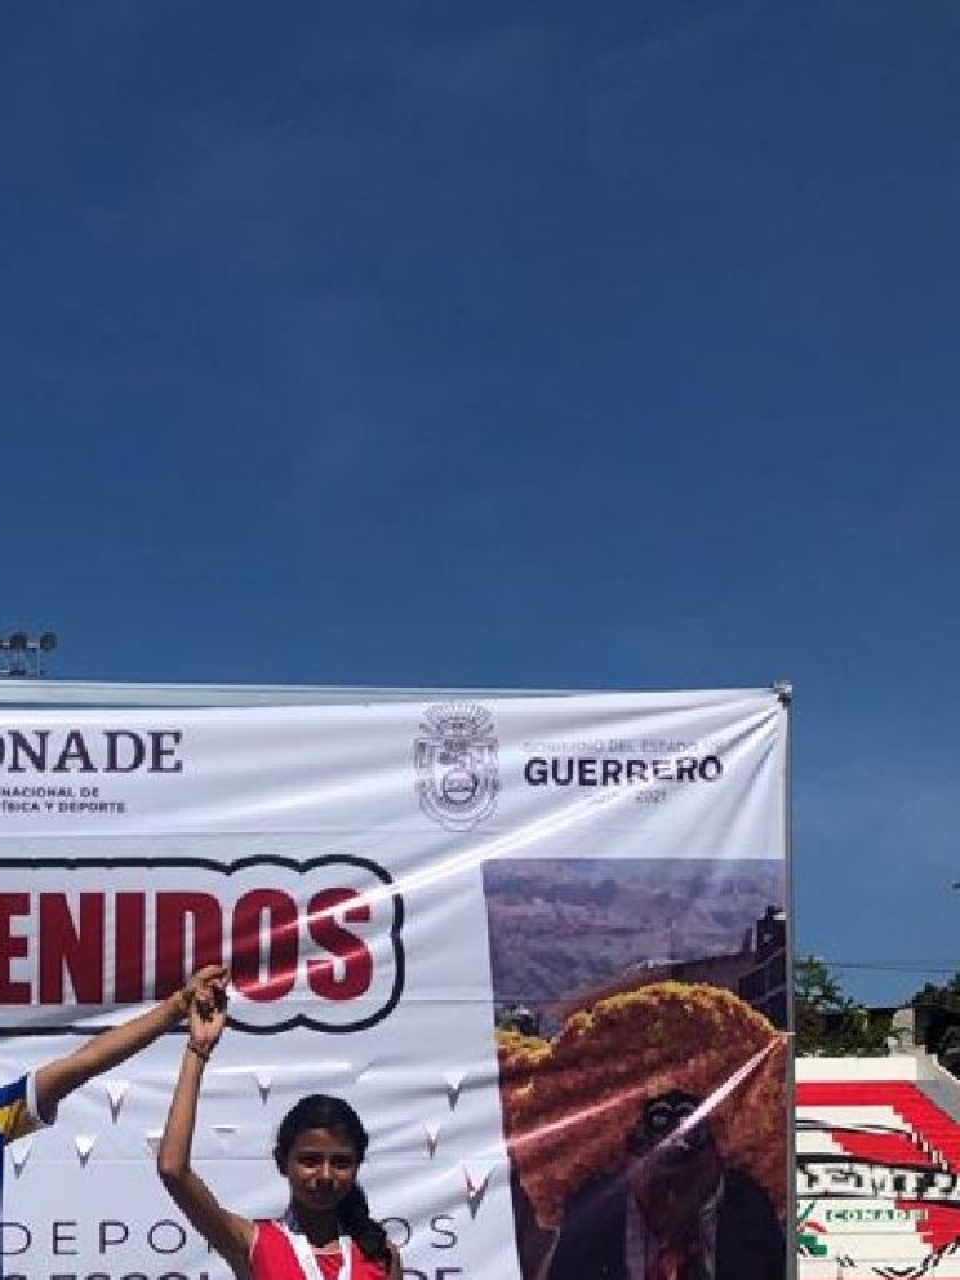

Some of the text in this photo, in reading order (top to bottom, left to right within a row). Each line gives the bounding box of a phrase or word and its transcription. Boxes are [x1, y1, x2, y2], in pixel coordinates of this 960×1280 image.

[524, 754, 724, 787] GUERRERO
[0, 786, 77, 798] NACIONAL
[79, 786, 100, 798] DE
[44, 802, 54, 813] Y
[58, 802, 126, 814] DEPORTE
